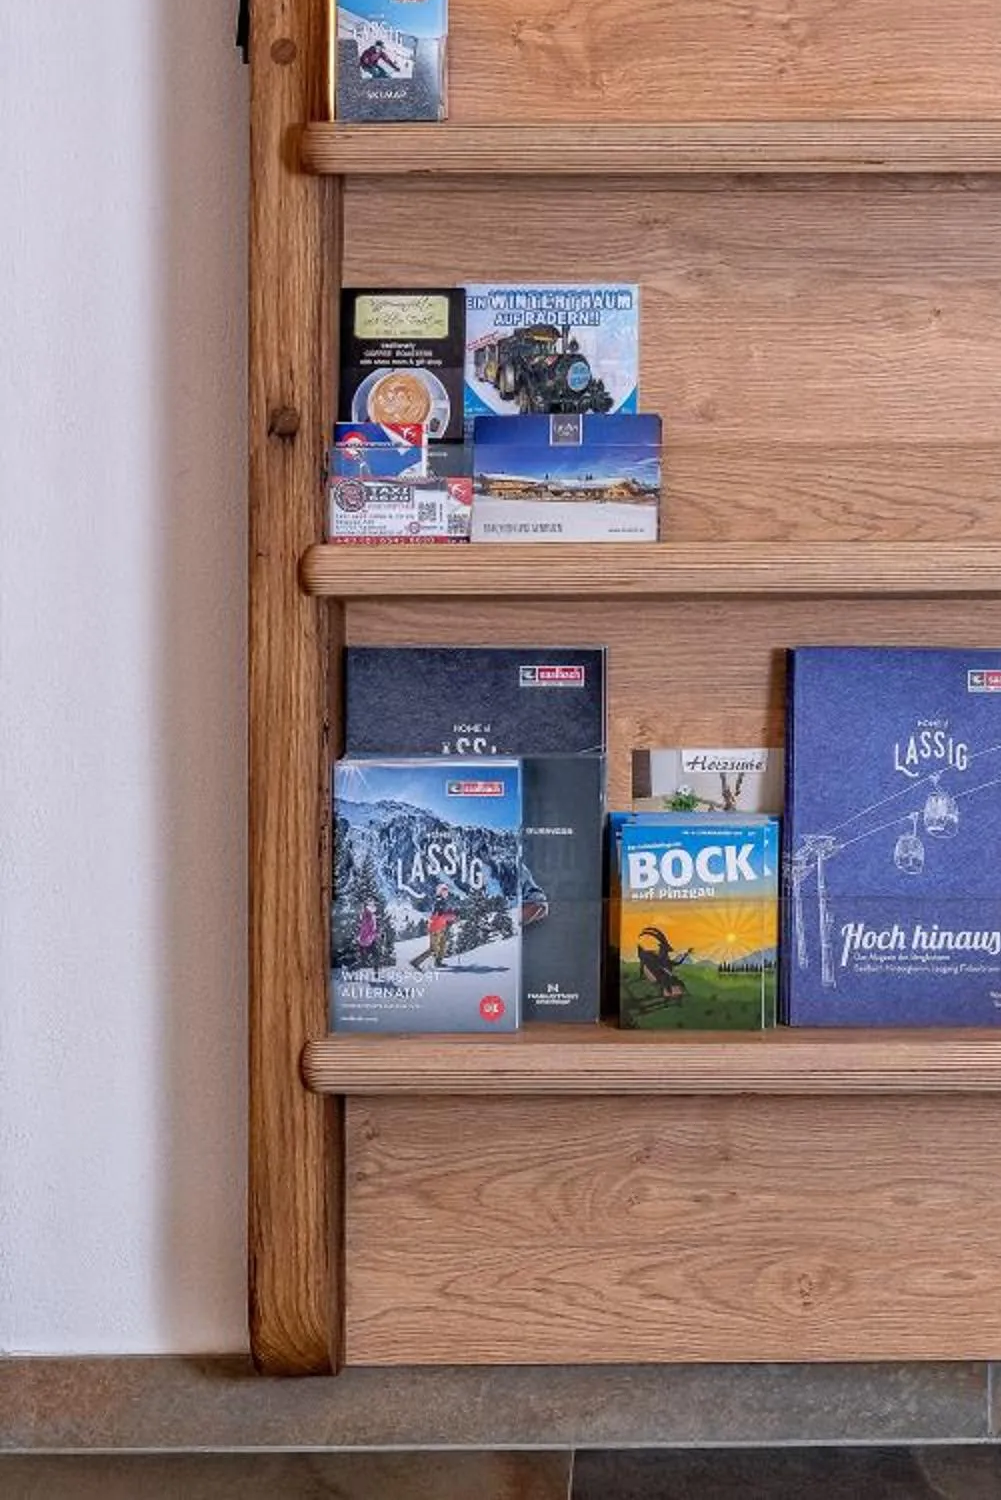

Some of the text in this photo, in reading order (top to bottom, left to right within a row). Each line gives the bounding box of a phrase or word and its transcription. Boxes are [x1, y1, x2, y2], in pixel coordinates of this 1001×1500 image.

[467, 296, 486, 310] EIN
[494, 313, 524, 326] AUF
[627, 843, 759, 890] BOCK
[840, 922, 1001, 967] Hoch hinaus
[341, 970, 441, 983] WINTERSPORT
[340, 987, 426, 999] ALTERNATIV
